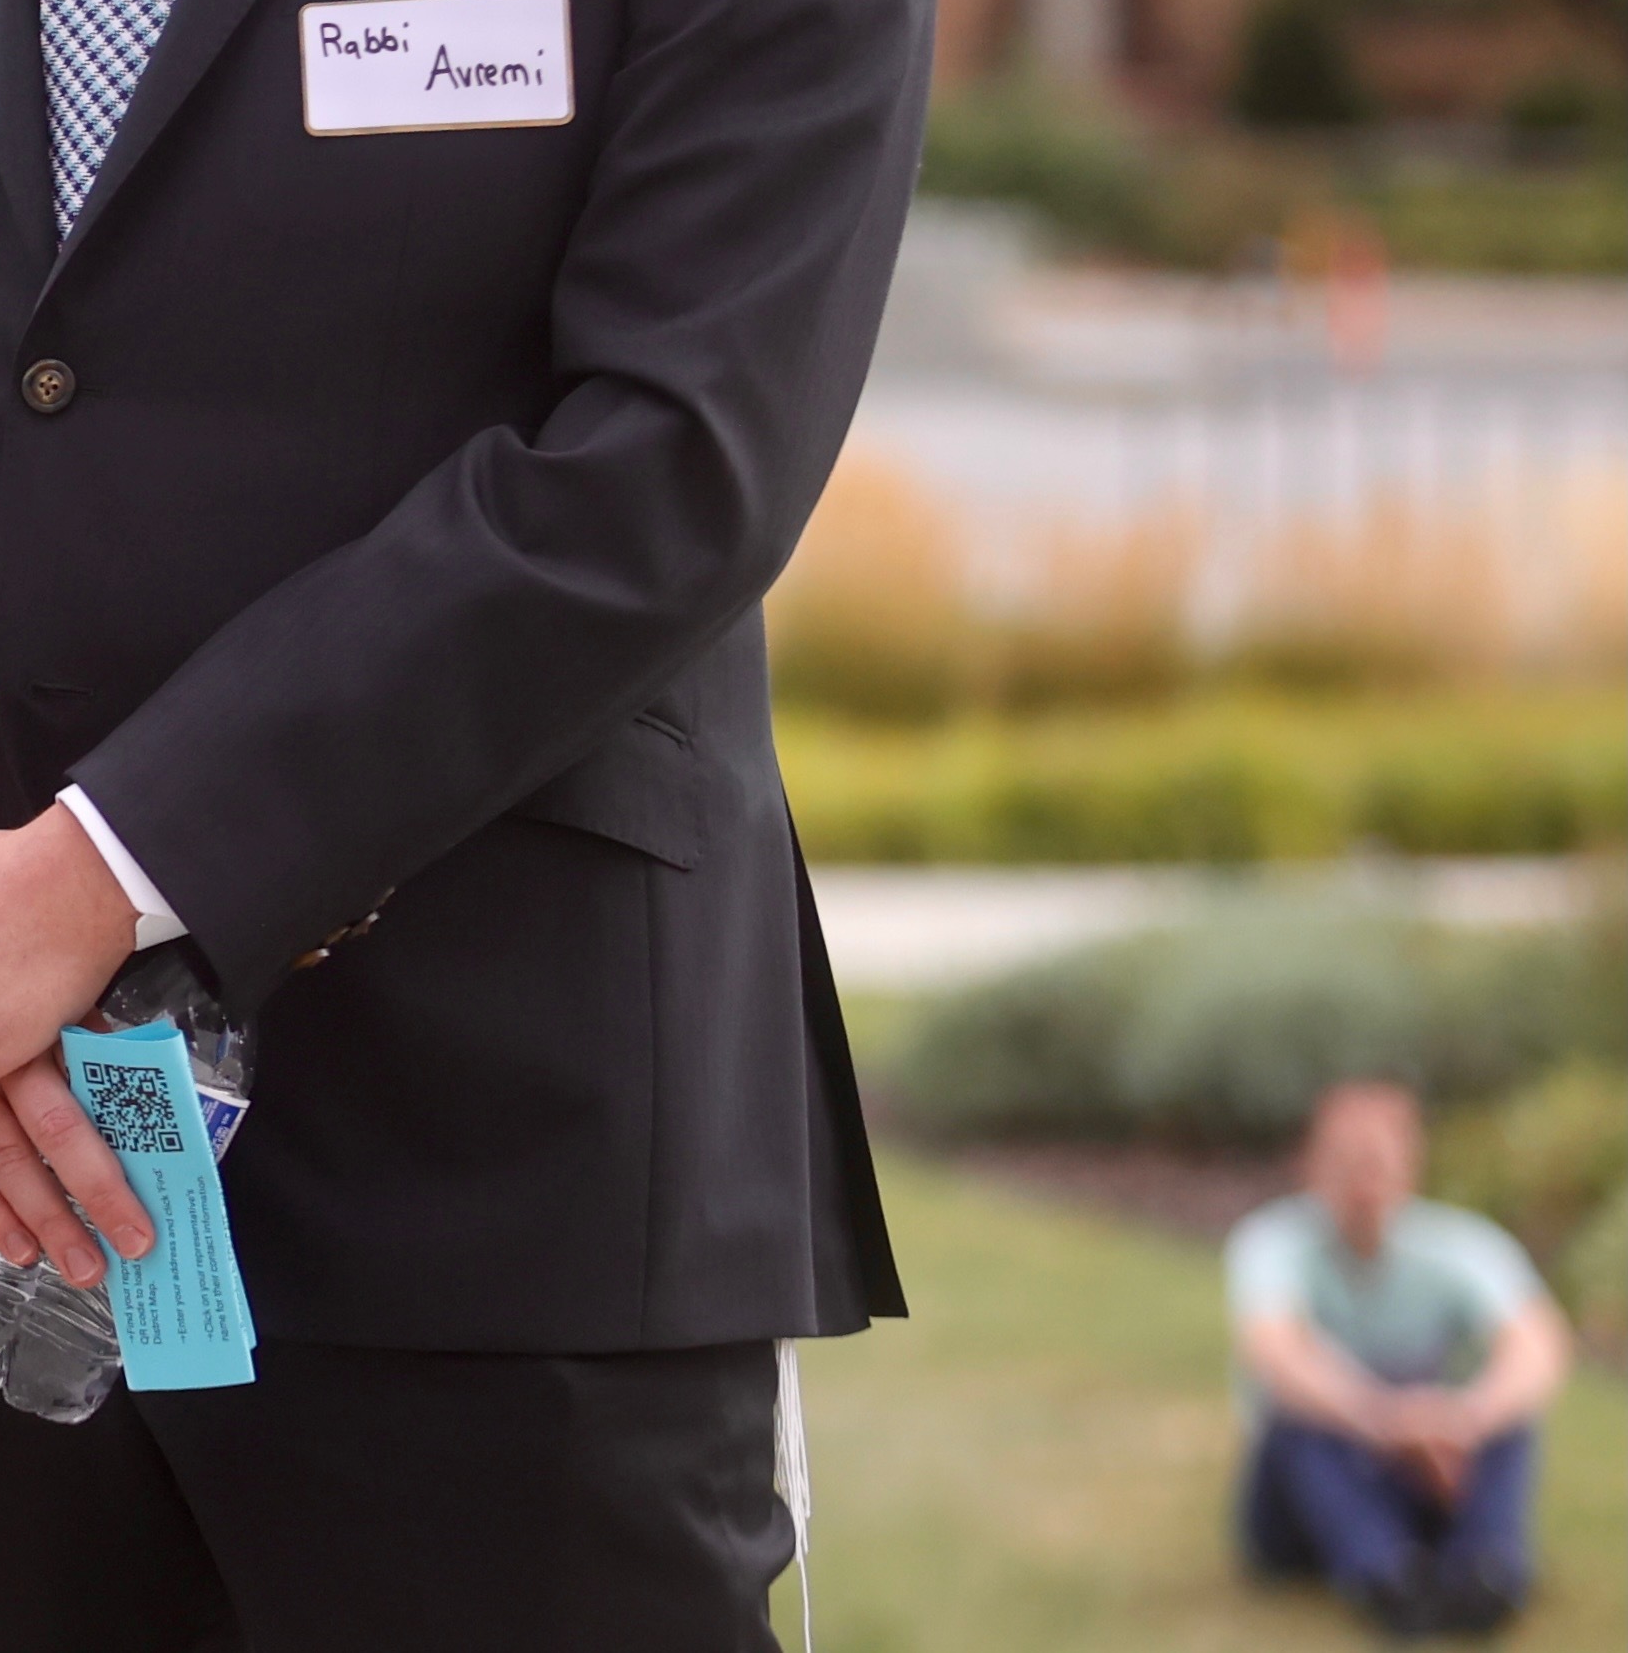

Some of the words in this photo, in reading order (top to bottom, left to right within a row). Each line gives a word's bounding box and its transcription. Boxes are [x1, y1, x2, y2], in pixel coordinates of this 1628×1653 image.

[320, 21, 409, 59] Rabbi
[425, 45, 545, 91] Avremi
[161, 1195, 172, 1216] click
[166, 1219, 175, 1238] and
[168, 1242, 180, 1280] address
[204, 1236, 218, 1271] contact
[133, 1264, 142, 1286] load
[199, 1275, 210, 1294] your
[136, 1289, 143, 1299] to
[175, 1290, 185, 1308] your
[212, 1281, 222, 1297] their
[125, 1291, 134, 1310] your
[203, 1296, 210, 1306] on
[216, 1302, 224, 1313] for
[123, 1312, 135, 1334] Find
[137, 1302, 146, 1325] code
[176, 1310, 187, 1335] Enter
[203, 1311, 214, 1333] Click
[139, 1329, 149, 1345] QR
[149, 1309, 161, 1345] District
[221, 1315, 229, 1342] name
